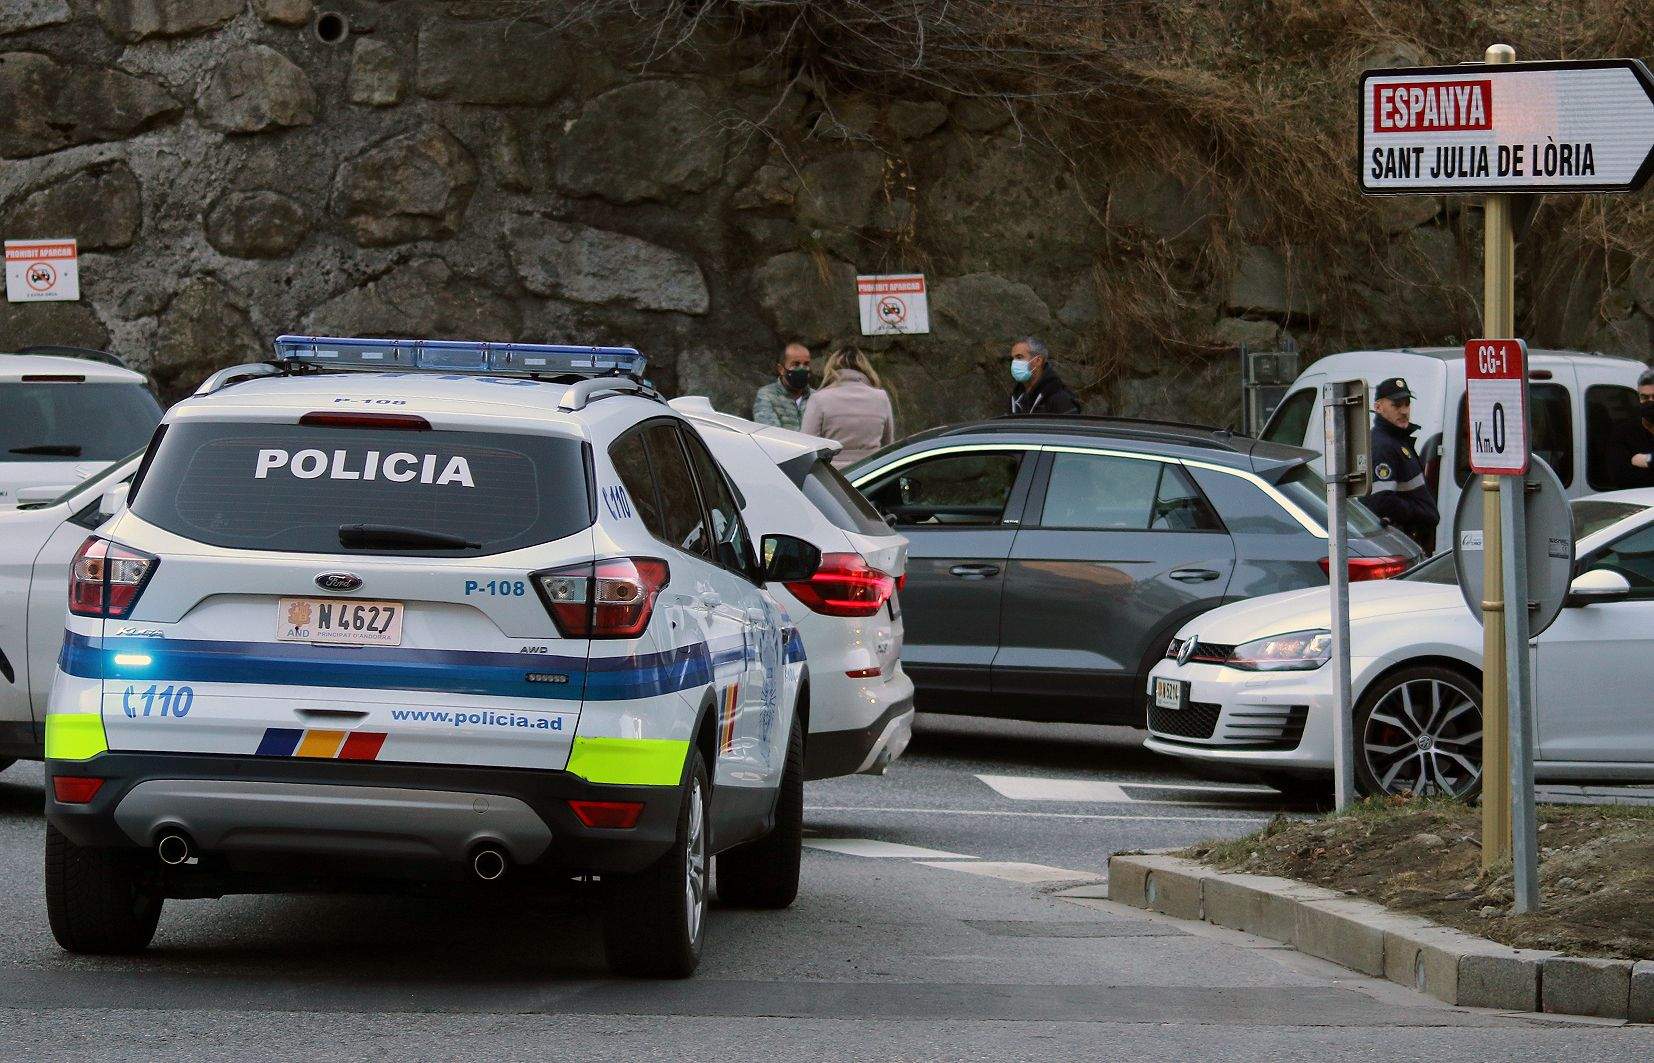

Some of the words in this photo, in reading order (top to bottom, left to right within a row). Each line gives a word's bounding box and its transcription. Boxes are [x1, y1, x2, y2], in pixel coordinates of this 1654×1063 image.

[1380, 85, 1485, 128] ESPANYA
[1371, 146, 1424, 179] SANT
[1430, 145, 1489, 179] JULIA
[1497, 144, 1524, 177] DE
[1532, 135, 1595, 177] LÒRIA
[5, 249, 38, 258] PROHIBIT
[39, 248, 72, 257] APARCAR
[1478, 345, 1507, 374] CG-1
[333, 397, 408, 406] P-108
[254, 448, 476, 489] POLICIA
[609, 485, 631, 519] 110
[325, 575, 351, 588] Ford
[465, 580, 525, 597] P-108
[286, 628, 310, 638] AND
[317, 631, 351, 639] PRINCIPAT
[520, 646, 548, 654] AWD
[140, 684, 194, 718] 110
[391, 709, 563, 731] www.policia.ad
